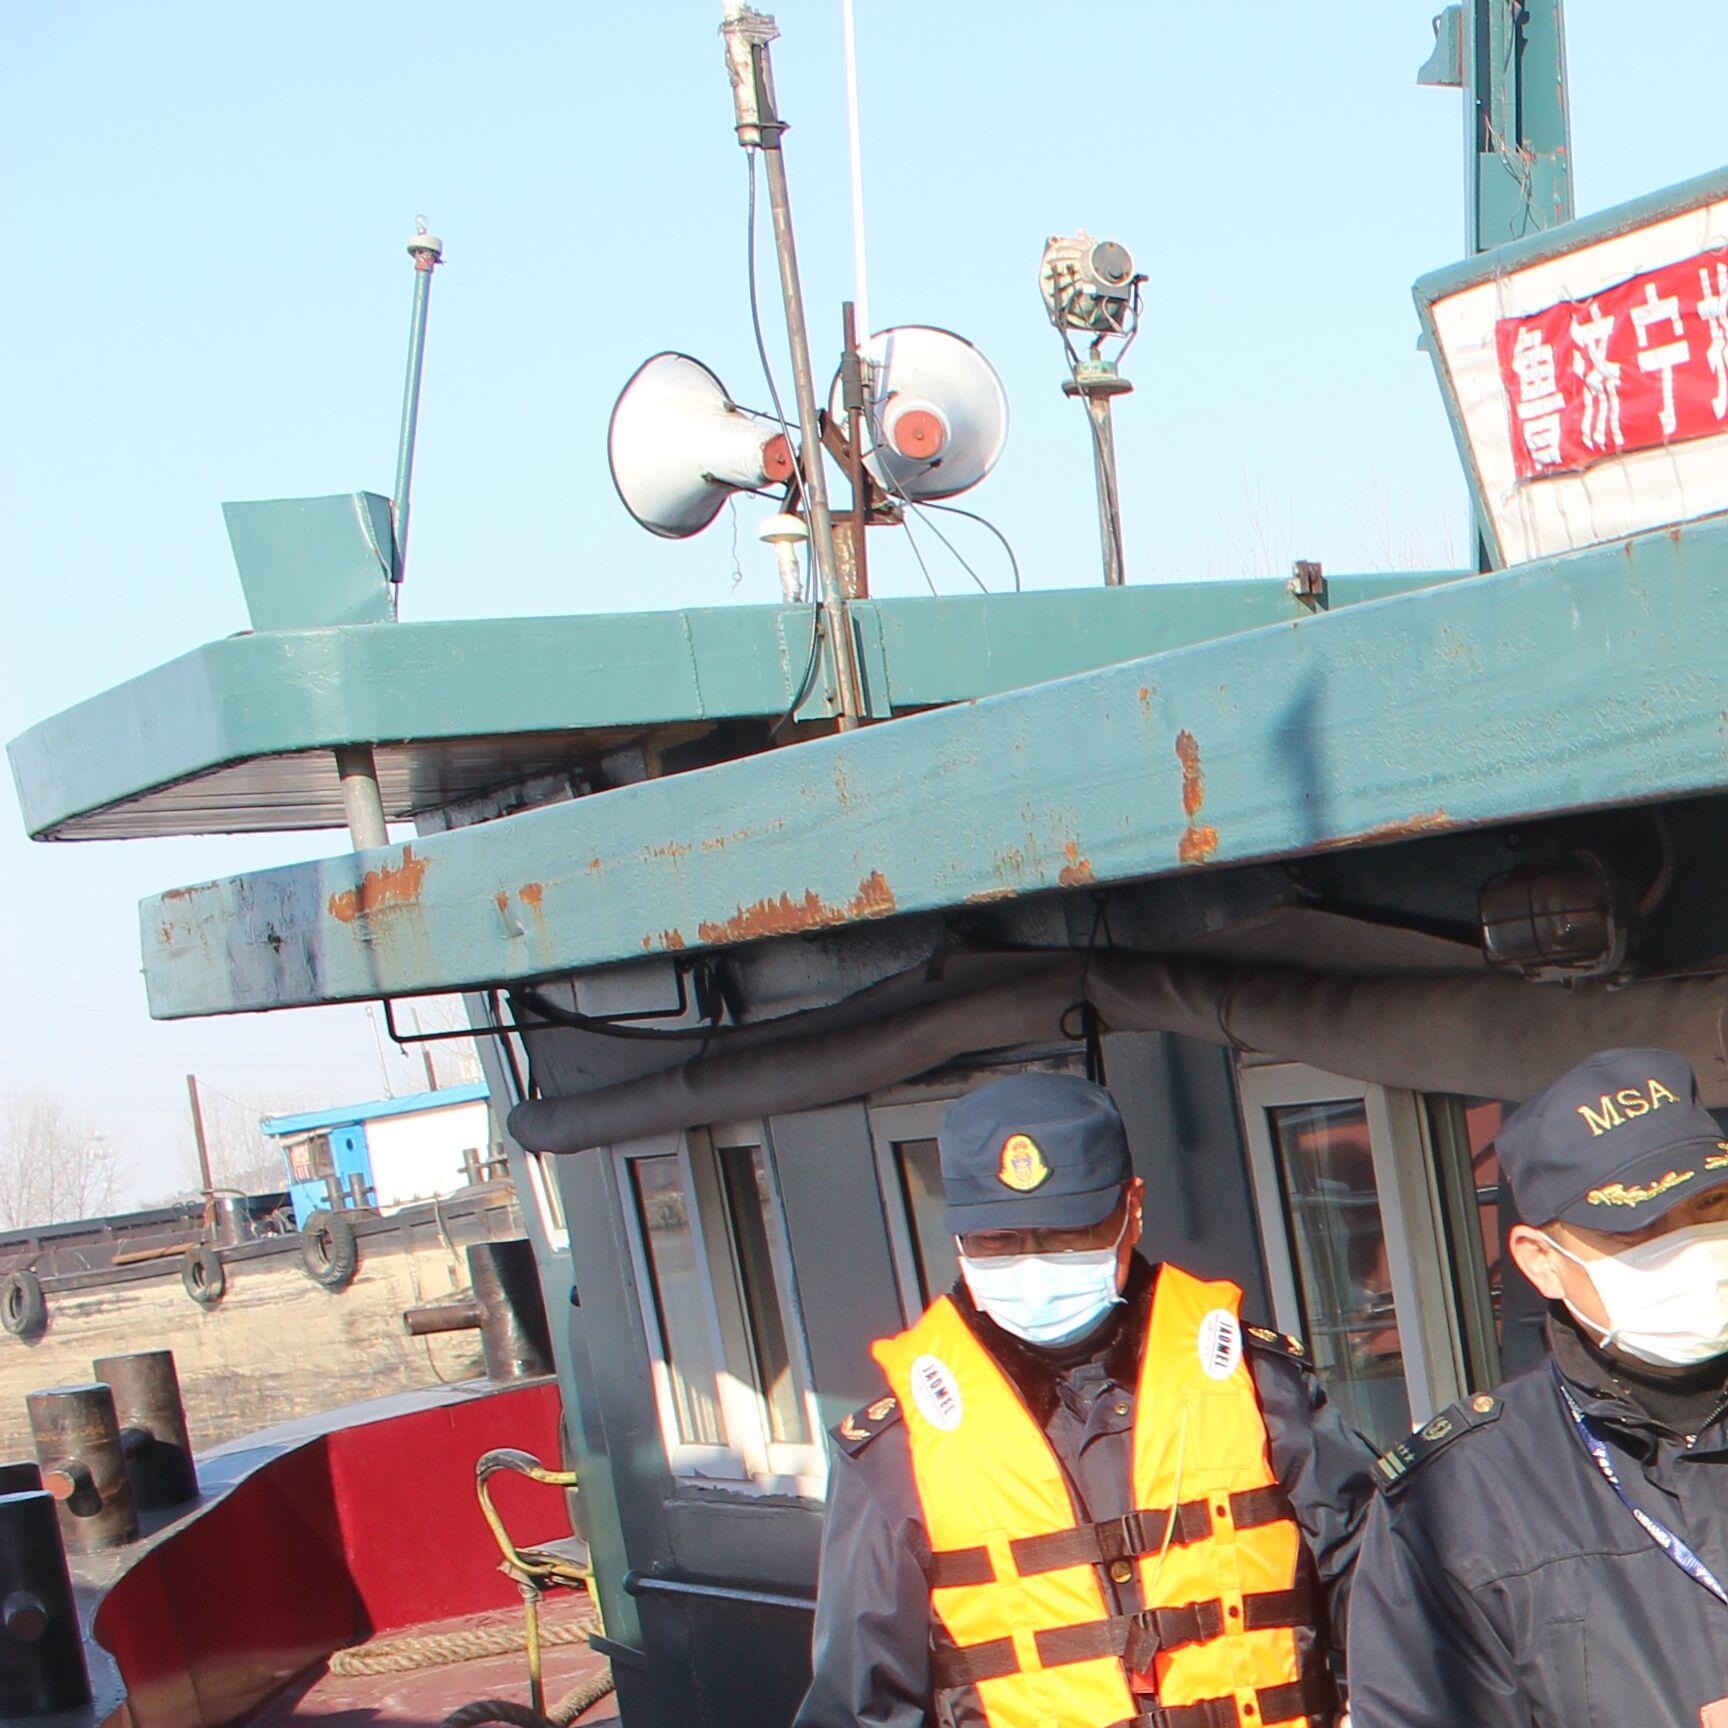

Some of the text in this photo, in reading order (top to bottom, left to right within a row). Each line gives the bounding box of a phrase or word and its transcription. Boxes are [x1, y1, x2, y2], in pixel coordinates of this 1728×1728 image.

[1576, 1079, 1680, 1136] MSA
[1213, 1319, 1235, 1369] JAOMEL
[921, 1363, 957, 1417] JAOMEL
